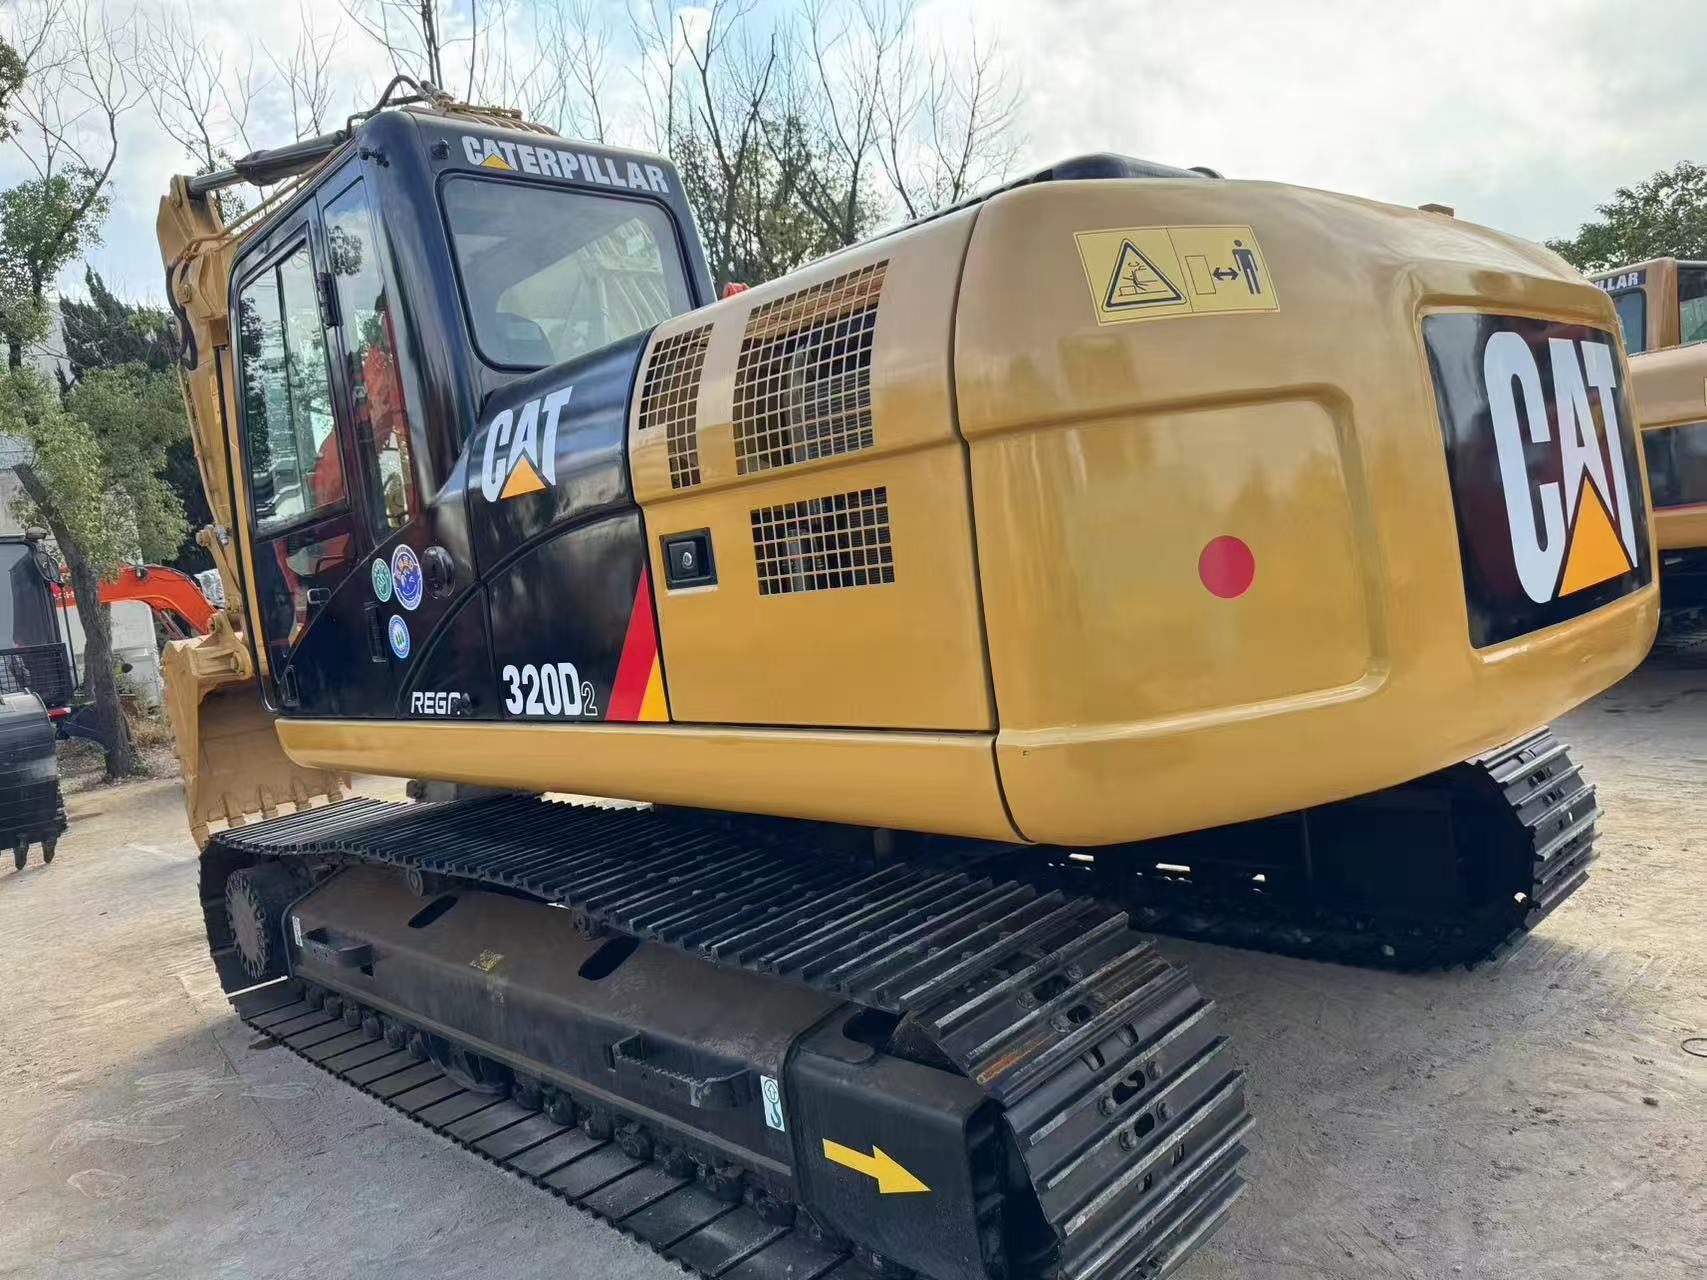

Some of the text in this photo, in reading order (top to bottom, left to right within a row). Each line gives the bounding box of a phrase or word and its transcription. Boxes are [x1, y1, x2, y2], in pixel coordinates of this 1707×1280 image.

[461, 135, 670, 193] CATERPILLAR
[481, 385, 574, 503] CAT
[1484, 331, 1639, 604] CAT
